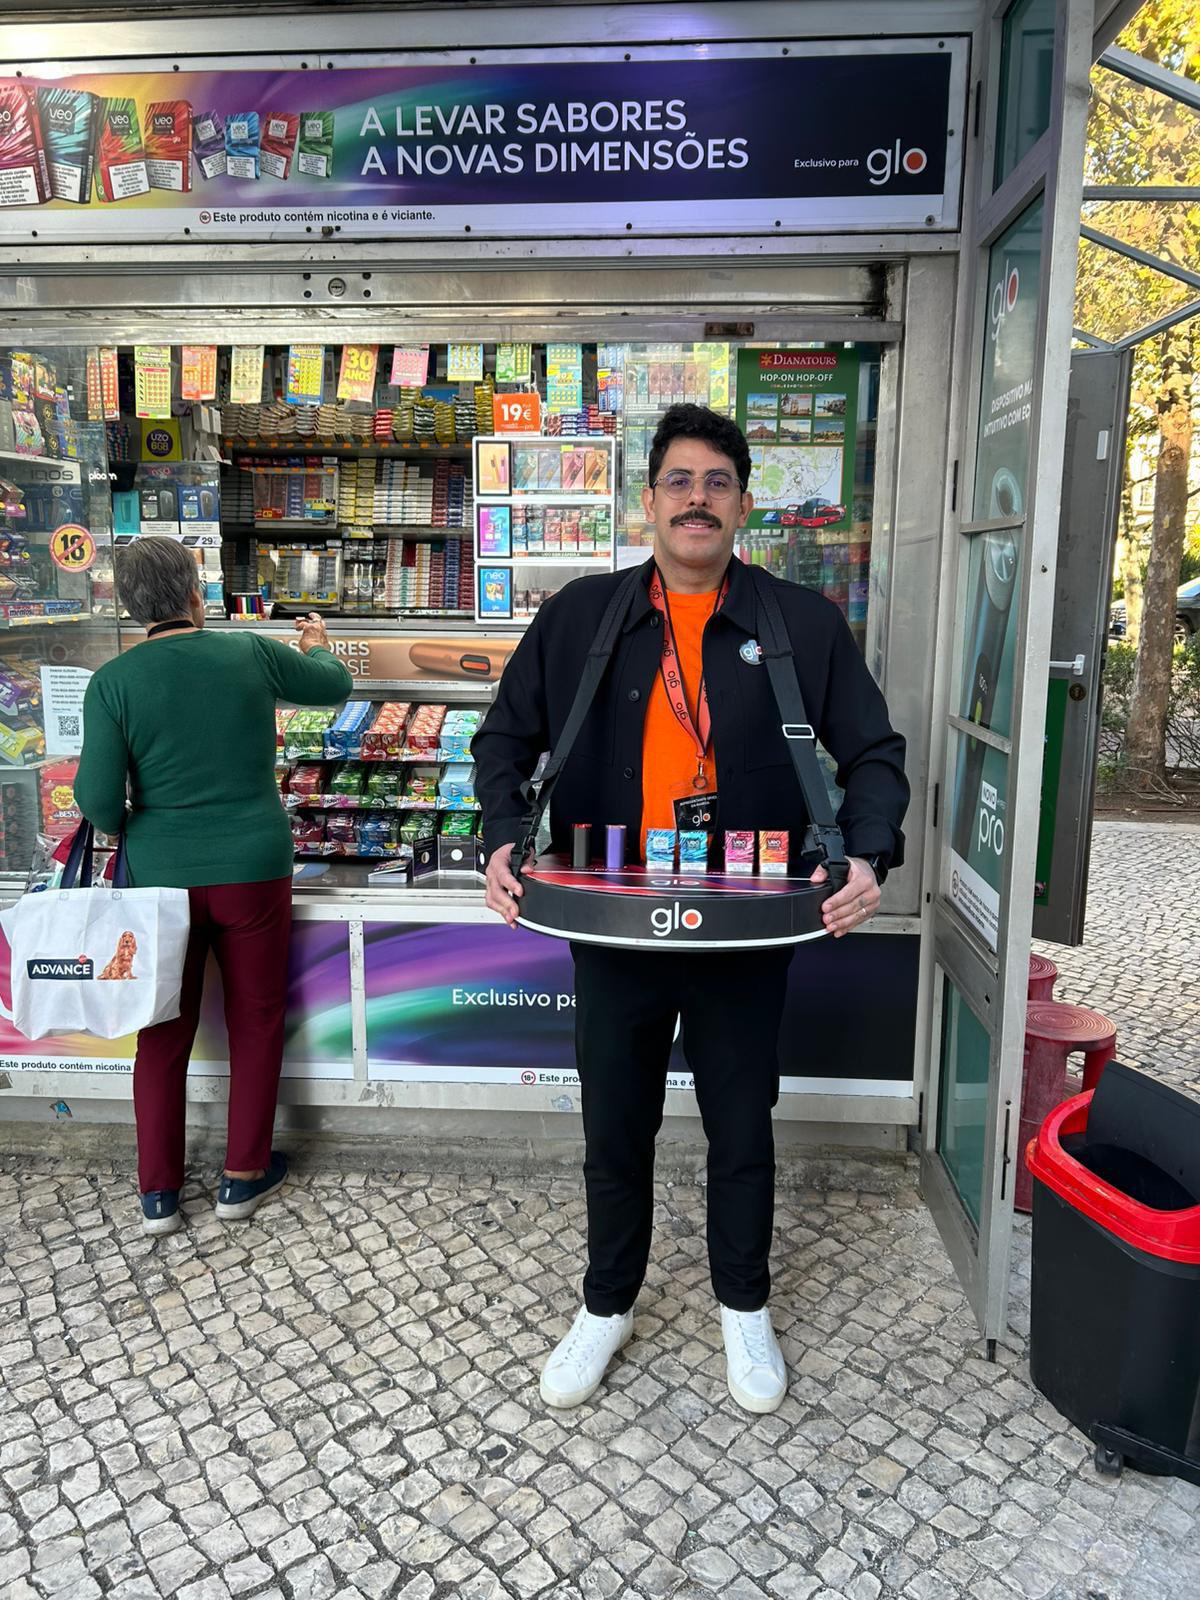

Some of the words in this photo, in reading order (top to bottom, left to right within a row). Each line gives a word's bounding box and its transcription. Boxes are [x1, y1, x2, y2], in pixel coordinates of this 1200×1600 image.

[0, 110, 11, 121] eo
[49, 107, 73, 121] veo
[111, 114, 129, 125] veo
[154, 116, 173, 126] veo
[359, 107, 386, 136] A
[395, 104, 506, 136] LEVAR
[517, 99, 687, 134] SABORES
[360, 146, 387, 175] A
[397, 144, 524, 175] NOVAS
[535, 131, 749, 174] DIMENSÕES
[794, 158, 836, 168] Exclusivo
[838, 158, 859, 169] para
[866, 137, 928, 185] glo
[213, 212, 236, 222] Este
[239, 211, 281, 224] produto
[284, 211, 323, 222] contém
[327, 210, 369, 221] nicotina
[372, 213, 379, 221] e
[381, 210, 388, 220] é
[391, 210, 435, 220] viciante.
[991, 259, 1019, 341] glo
[345, 347, 374, 370] 30
[343, 369, 371, 382] ANOS
[760, 373, 794, 382] HOP-ON
[796, 373, 833, 382] HOP-OFF
[501, 402, 532, 421] 19€
[60, 534, 85, 561] 18
[667, 671, 681, 689] glo
[676, 702, 689, 720] glo
[692, 809, 710, 827] glo
[978, 807, 1005, 856] pro
[651, 902, 703, 937] glo
[32, 963, 91, 975] ADVANCE
[452, 988, 551, 1008] Exclusivo
[556, 993, 577, 1012] pa
[0, 1060, 19, 1068] Este
[21, 1060, 57, 1069] produto
[60, 1061, 93, 1070] contém
[96, 1062, 131, 1072] nicotina
[539, 1073, 559, 1083] Este
